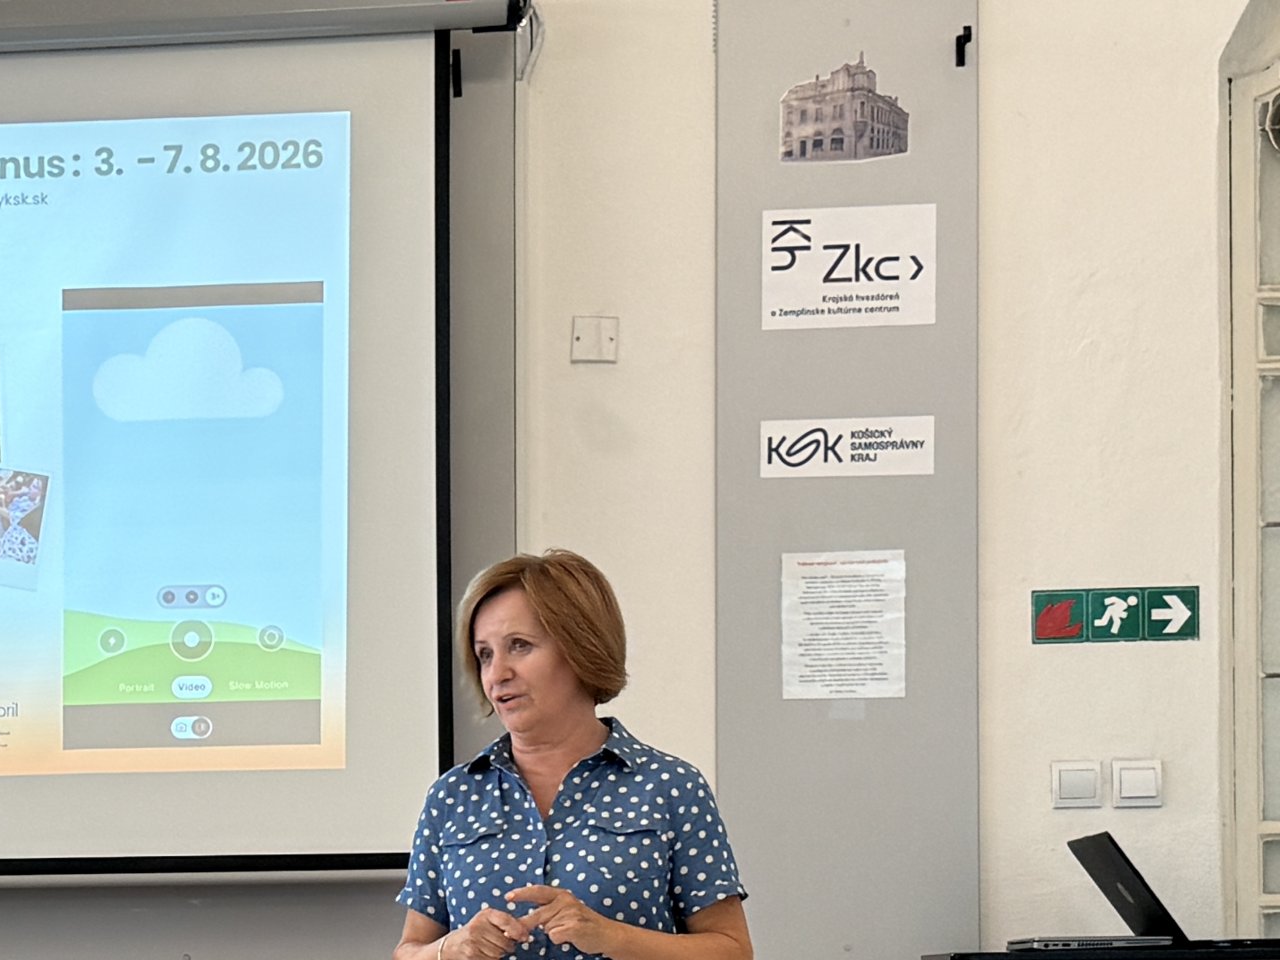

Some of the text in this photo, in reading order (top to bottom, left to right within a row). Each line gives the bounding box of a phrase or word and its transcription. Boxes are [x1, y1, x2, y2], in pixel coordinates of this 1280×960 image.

[94, 146, 124, 176] 3.
[822, 294, 854, 304] Krajská
[779, 307, 825, 317] Zemplínske
[827, 306, 862, 315] kultúrne
[864, 304, 900, 313] centrum
[850, 428, 893, 440] KOŠICKÝ
[850, 439, 925, 451] SAMOSPRÁVNY
[850, 453, 877, 462] KRAJ
[178, 682, 206, 691] Video
[254, 680, 289, 691] Motion
